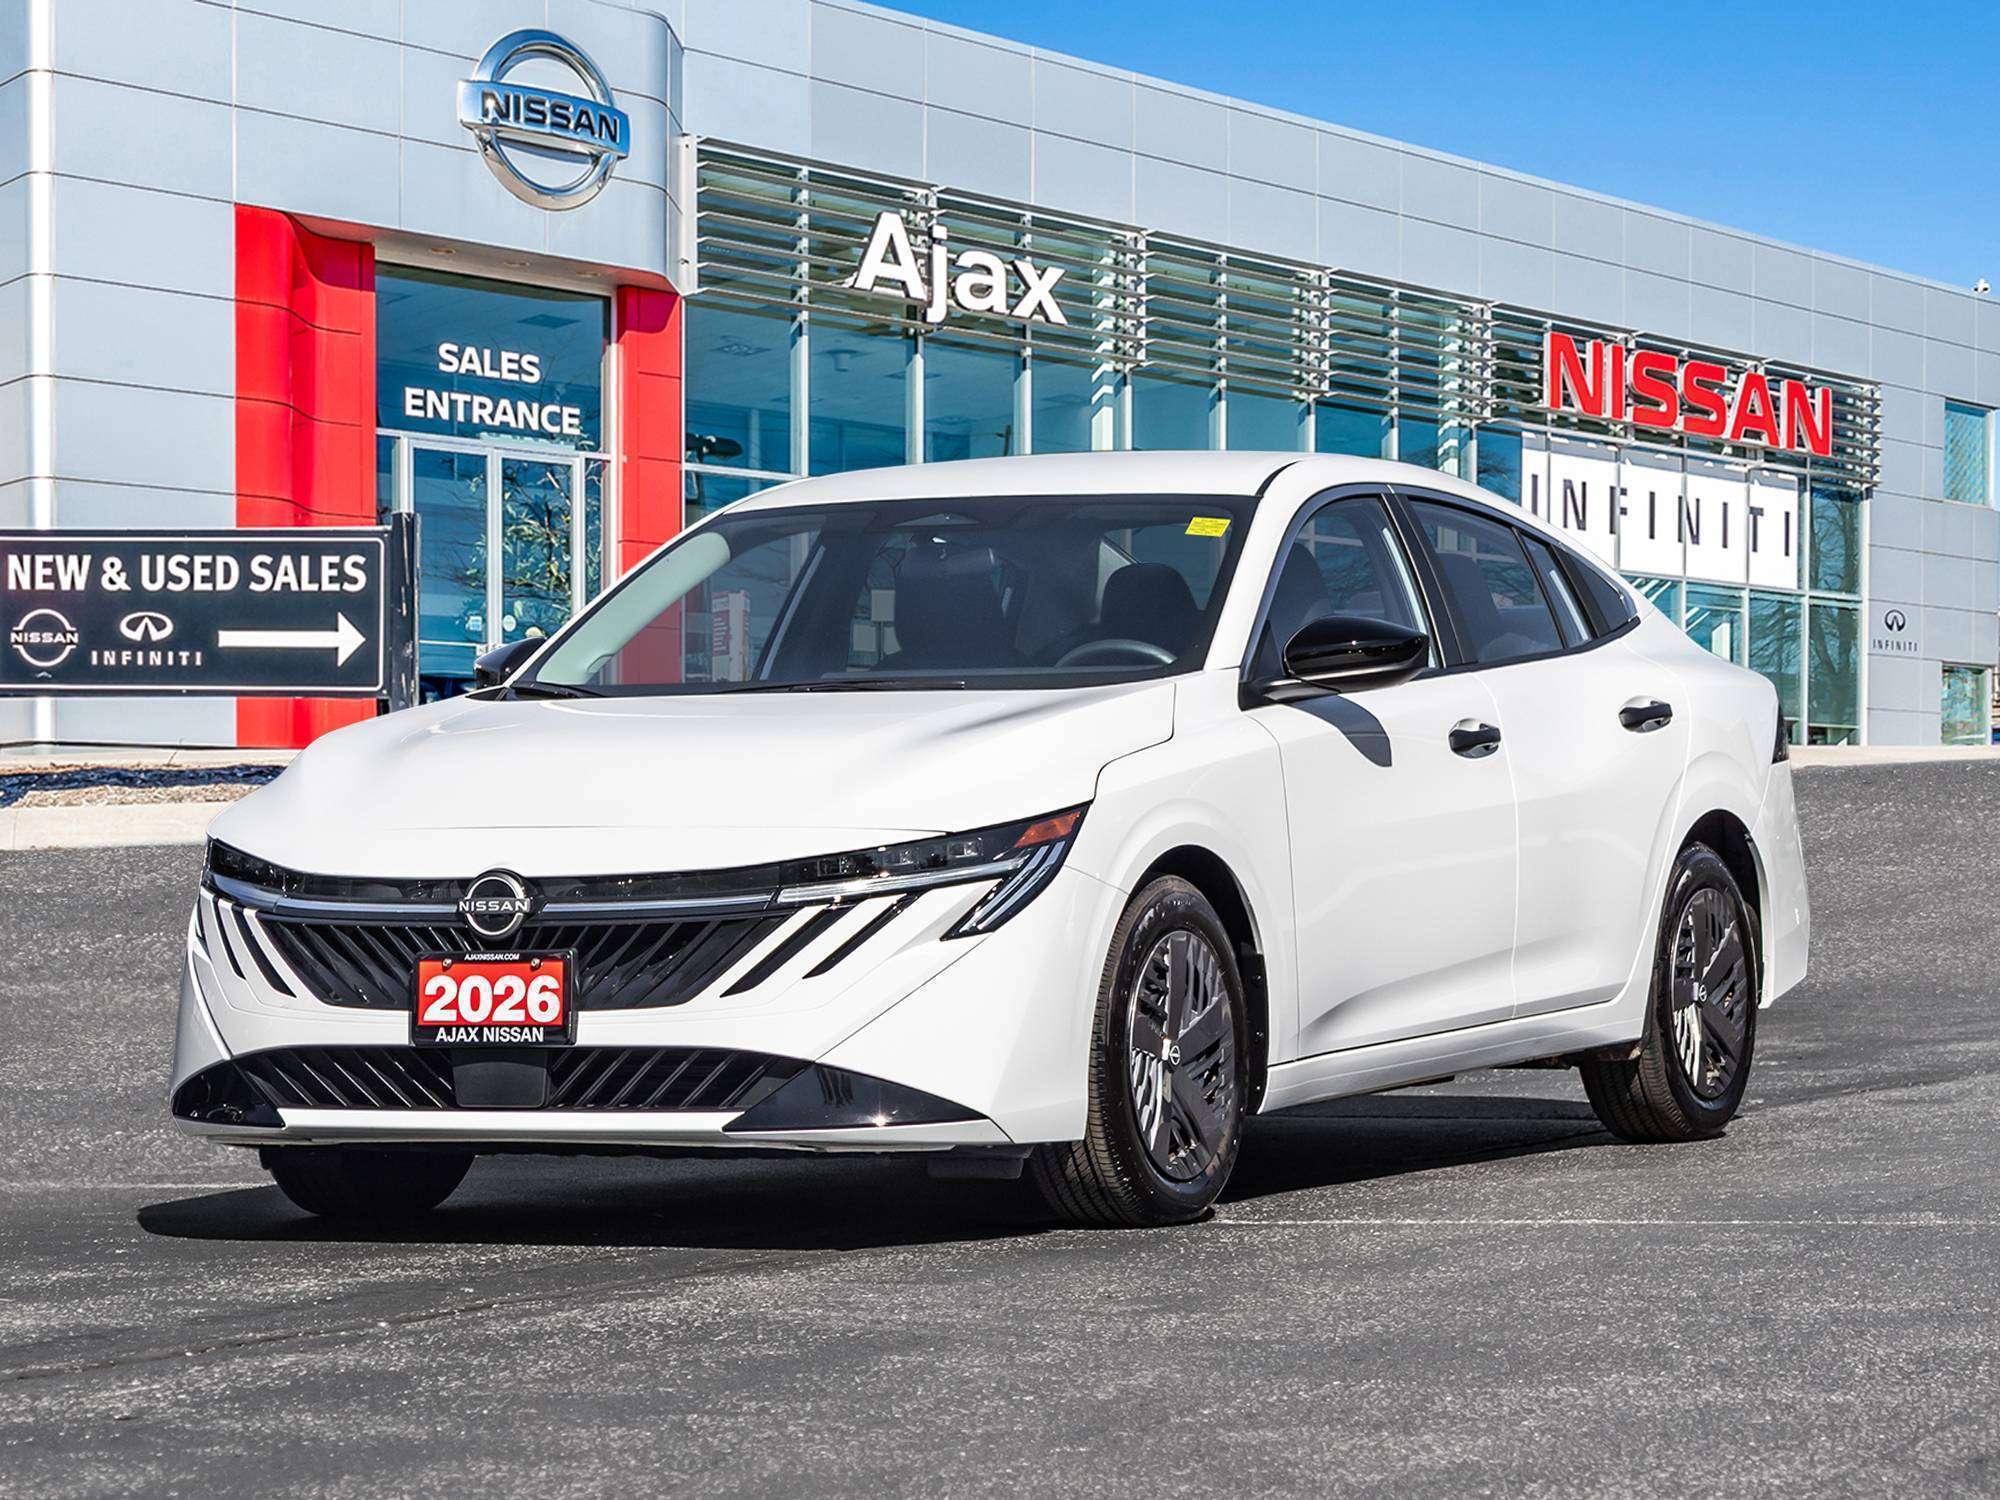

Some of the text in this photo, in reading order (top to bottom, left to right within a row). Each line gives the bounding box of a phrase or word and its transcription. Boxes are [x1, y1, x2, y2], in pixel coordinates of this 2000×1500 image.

[483, 92, 620, 144] NISSAN
[852, 210, 1068, 325] Ajax
[438, 342, 541, 384] SALES
[404, 387, 582, 436] ENTRANCE
[1546, 332, 1833, 456] NISSAN
[1530, 474, 1791, 557] INFINITI
[7, 553, 368, 593] NEW & USED SALES
[10, 630, 79, 644] NISSAN
[1872, 639, 1919, 652] INFINITI
[91, 650, 203, 666] INFINITI
[458, 900, 529, 912] NISSAN
[464, 953, 520, 961] AJAXNISSAN.COM
[423, 974, 561, 1023] 2026
[435, 1027, 544, 1043] AJAX NISSAN
